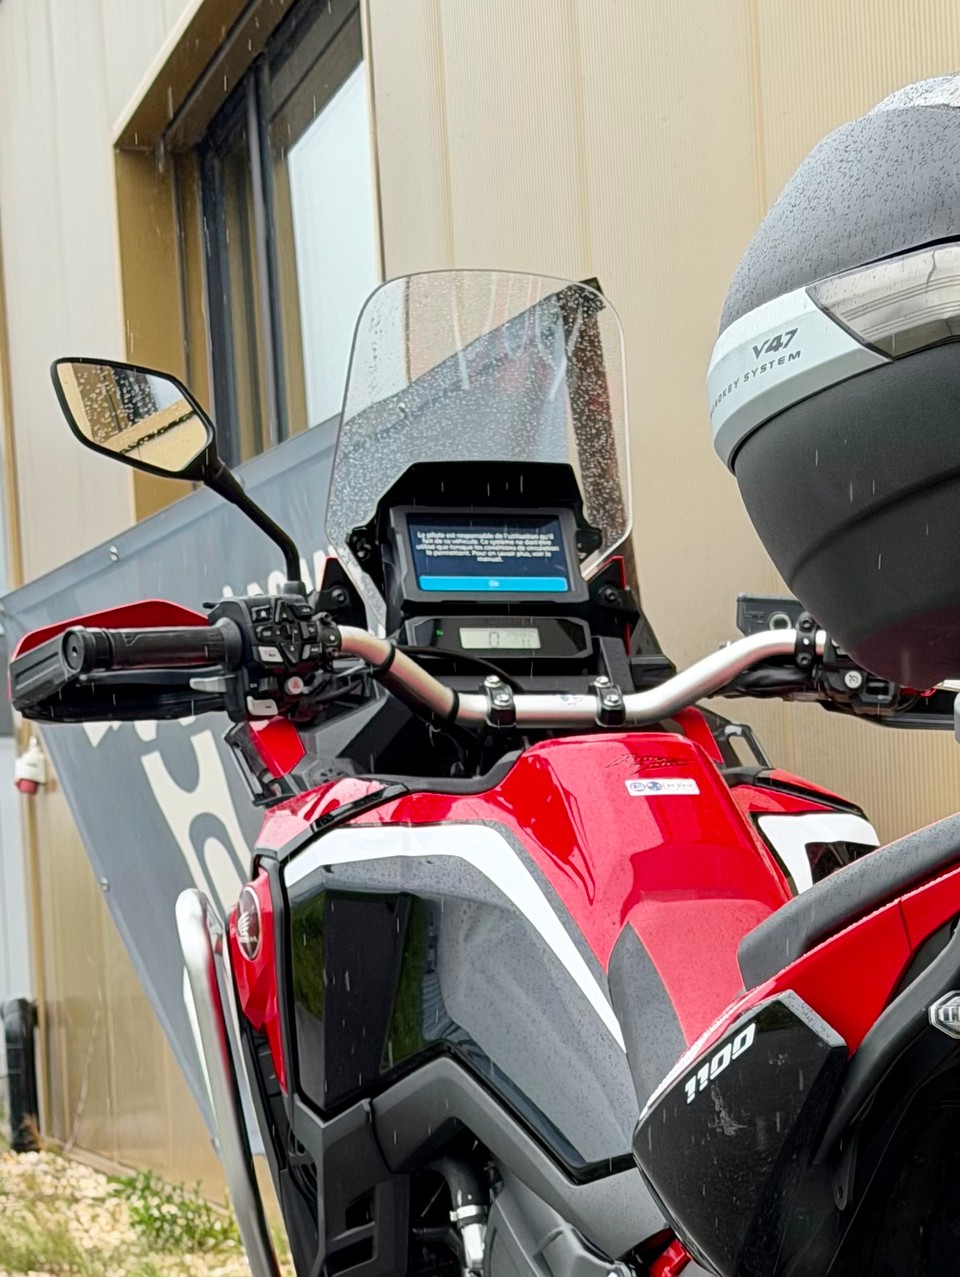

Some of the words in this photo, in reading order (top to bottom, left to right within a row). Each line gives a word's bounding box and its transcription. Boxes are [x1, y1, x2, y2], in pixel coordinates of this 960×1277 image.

[752, 328, 798, 359] V47
[743, 350, 801, 383] SYSTEM
[685, 1023, 756, 1104] 1100
